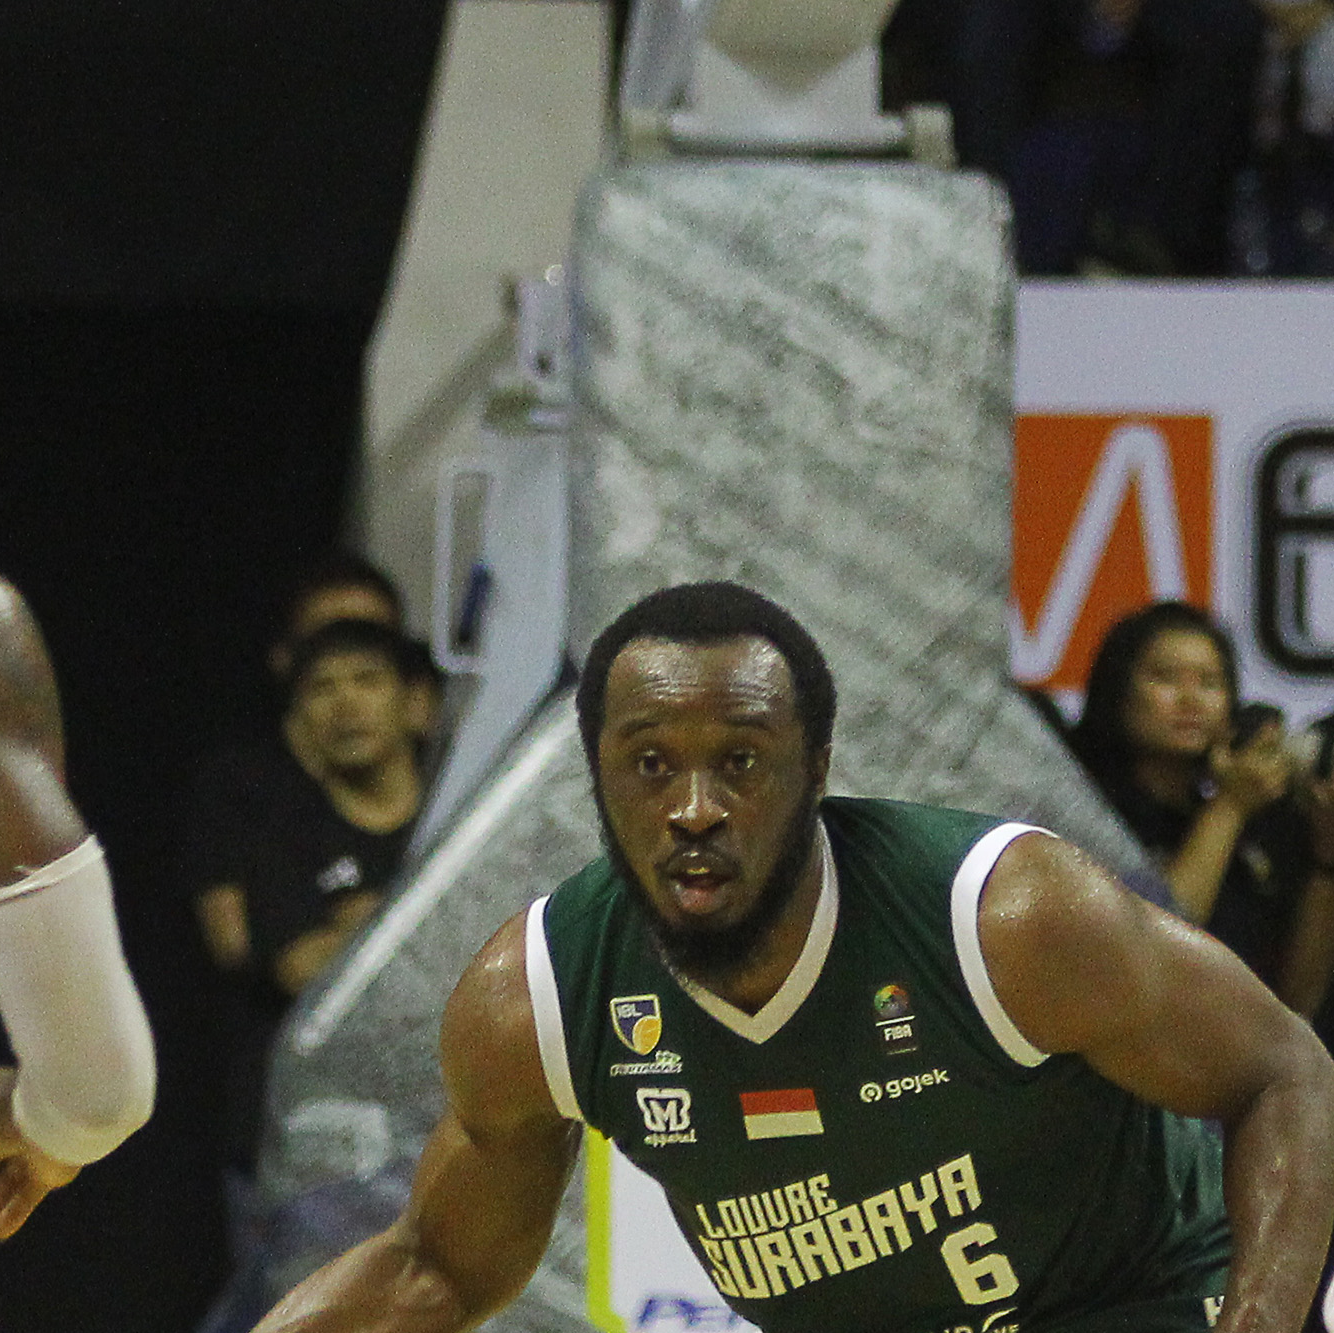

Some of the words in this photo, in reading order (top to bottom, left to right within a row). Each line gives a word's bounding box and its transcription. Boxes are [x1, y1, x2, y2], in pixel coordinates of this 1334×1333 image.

[883, 1023, 914, 1041] FIBA
[885, 1068, 951, 1099] gojek
[695, 1172, 839, 1240] LOUVRE
[698, 1153, 983, 1299] SURABAYA
[939, 1221, 1020, 1305] 6
